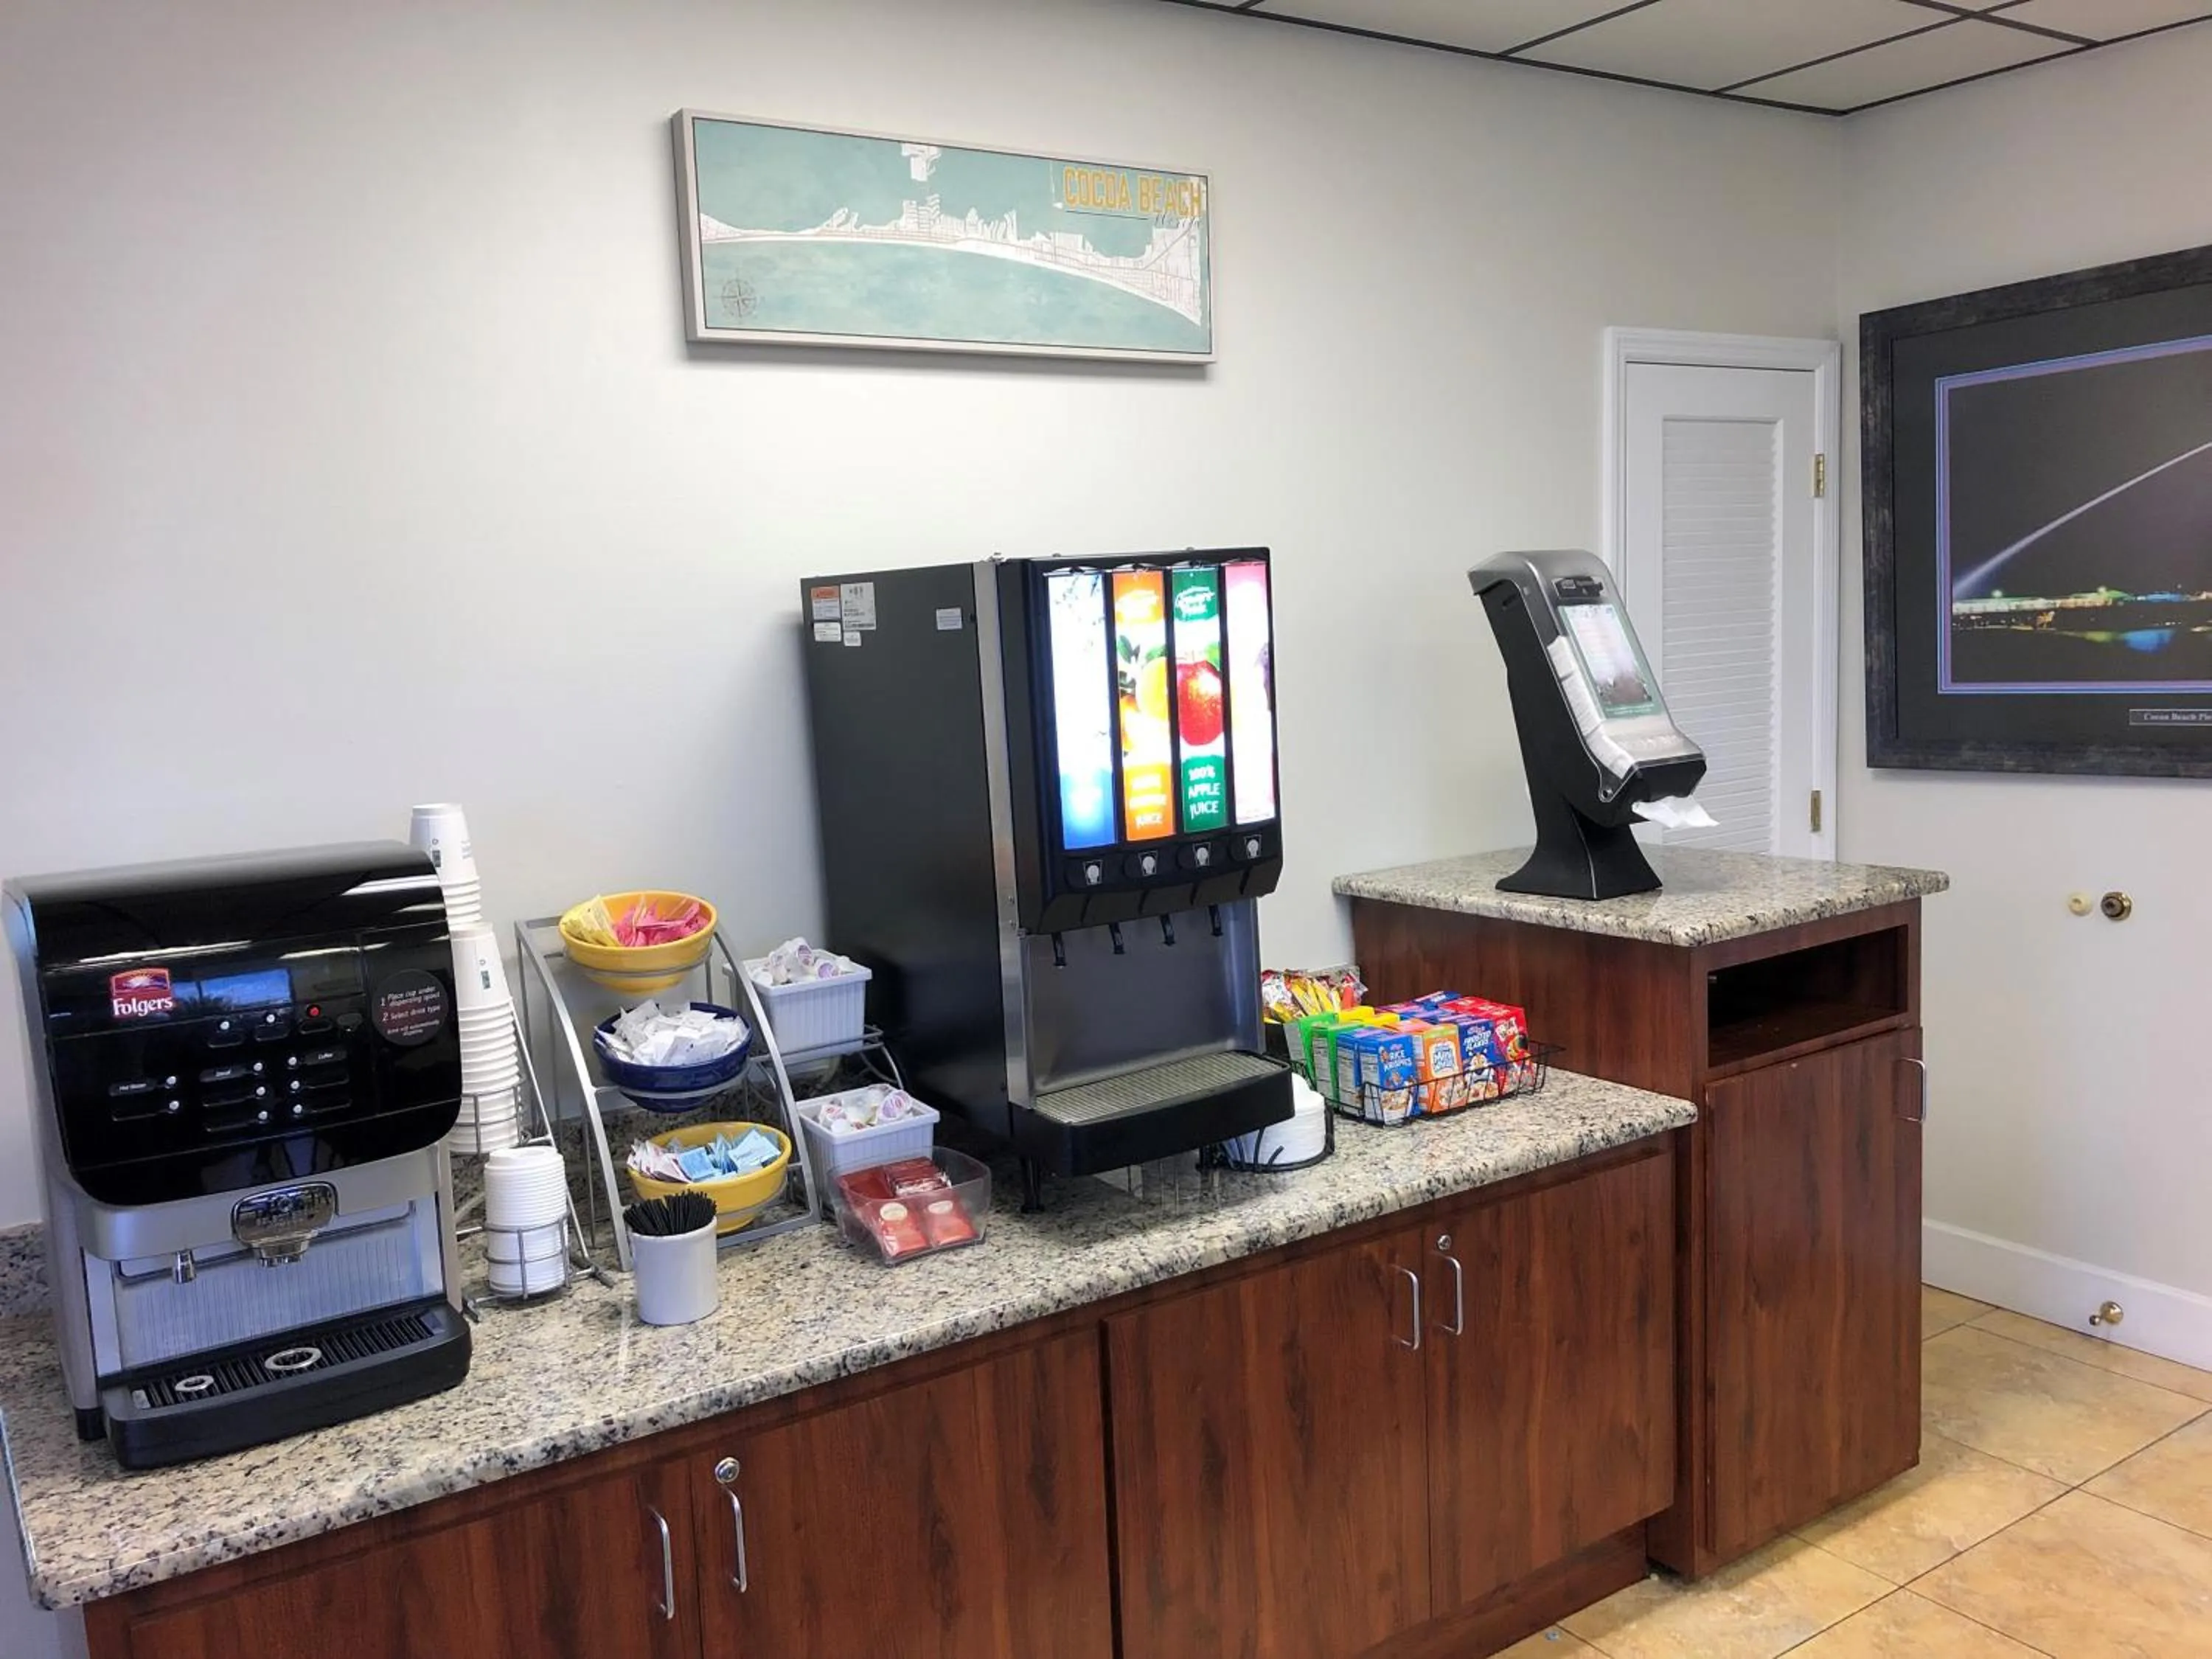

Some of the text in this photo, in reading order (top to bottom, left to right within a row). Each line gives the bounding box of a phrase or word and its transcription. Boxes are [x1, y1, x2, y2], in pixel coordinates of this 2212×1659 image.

[1064, 167, 1201, 217] COCOA BEACH
[1189, 782, 1221, 799] APPLE
[1189, 800, 1219, 820] JUICE
[113, 997, 174, 1018] Folgers
[381, 997, 386, 1006] 1
[383, 1012, 389, 1022] 2
